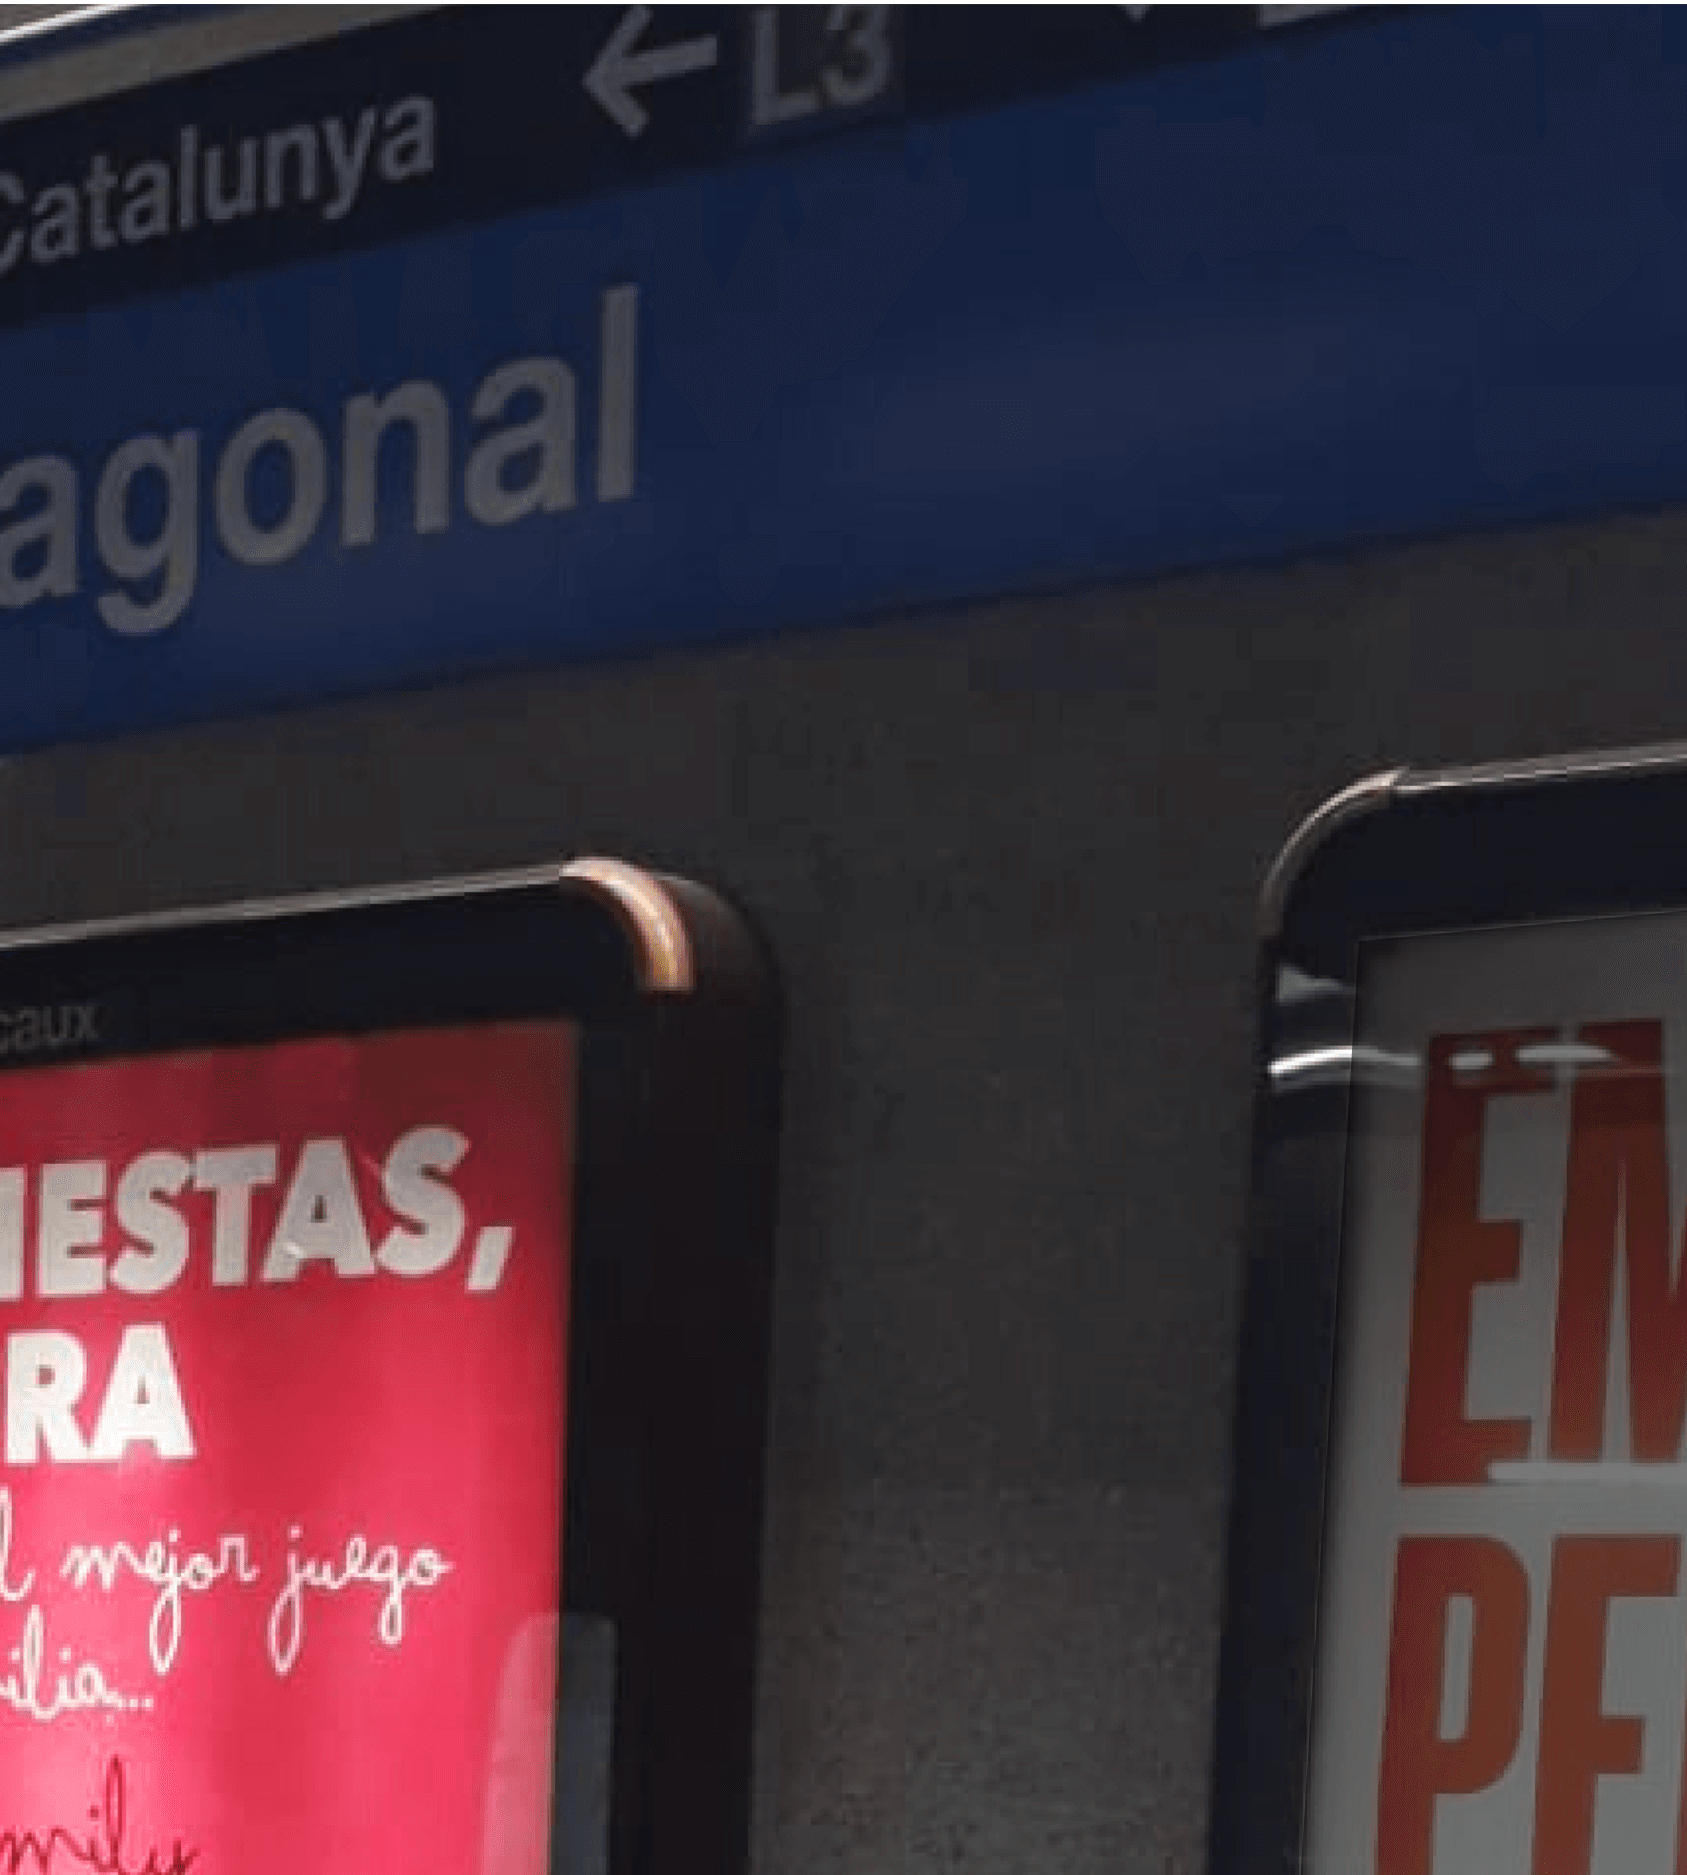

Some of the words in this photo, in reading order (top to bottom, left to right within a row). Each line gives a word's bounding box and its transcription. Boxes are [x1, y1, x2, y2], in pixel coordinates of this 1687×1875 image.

[750, 4, 889, 125] L3
[61, 1528, 259, 1674] mejor
[268, 1526, 455, 1674] juego
